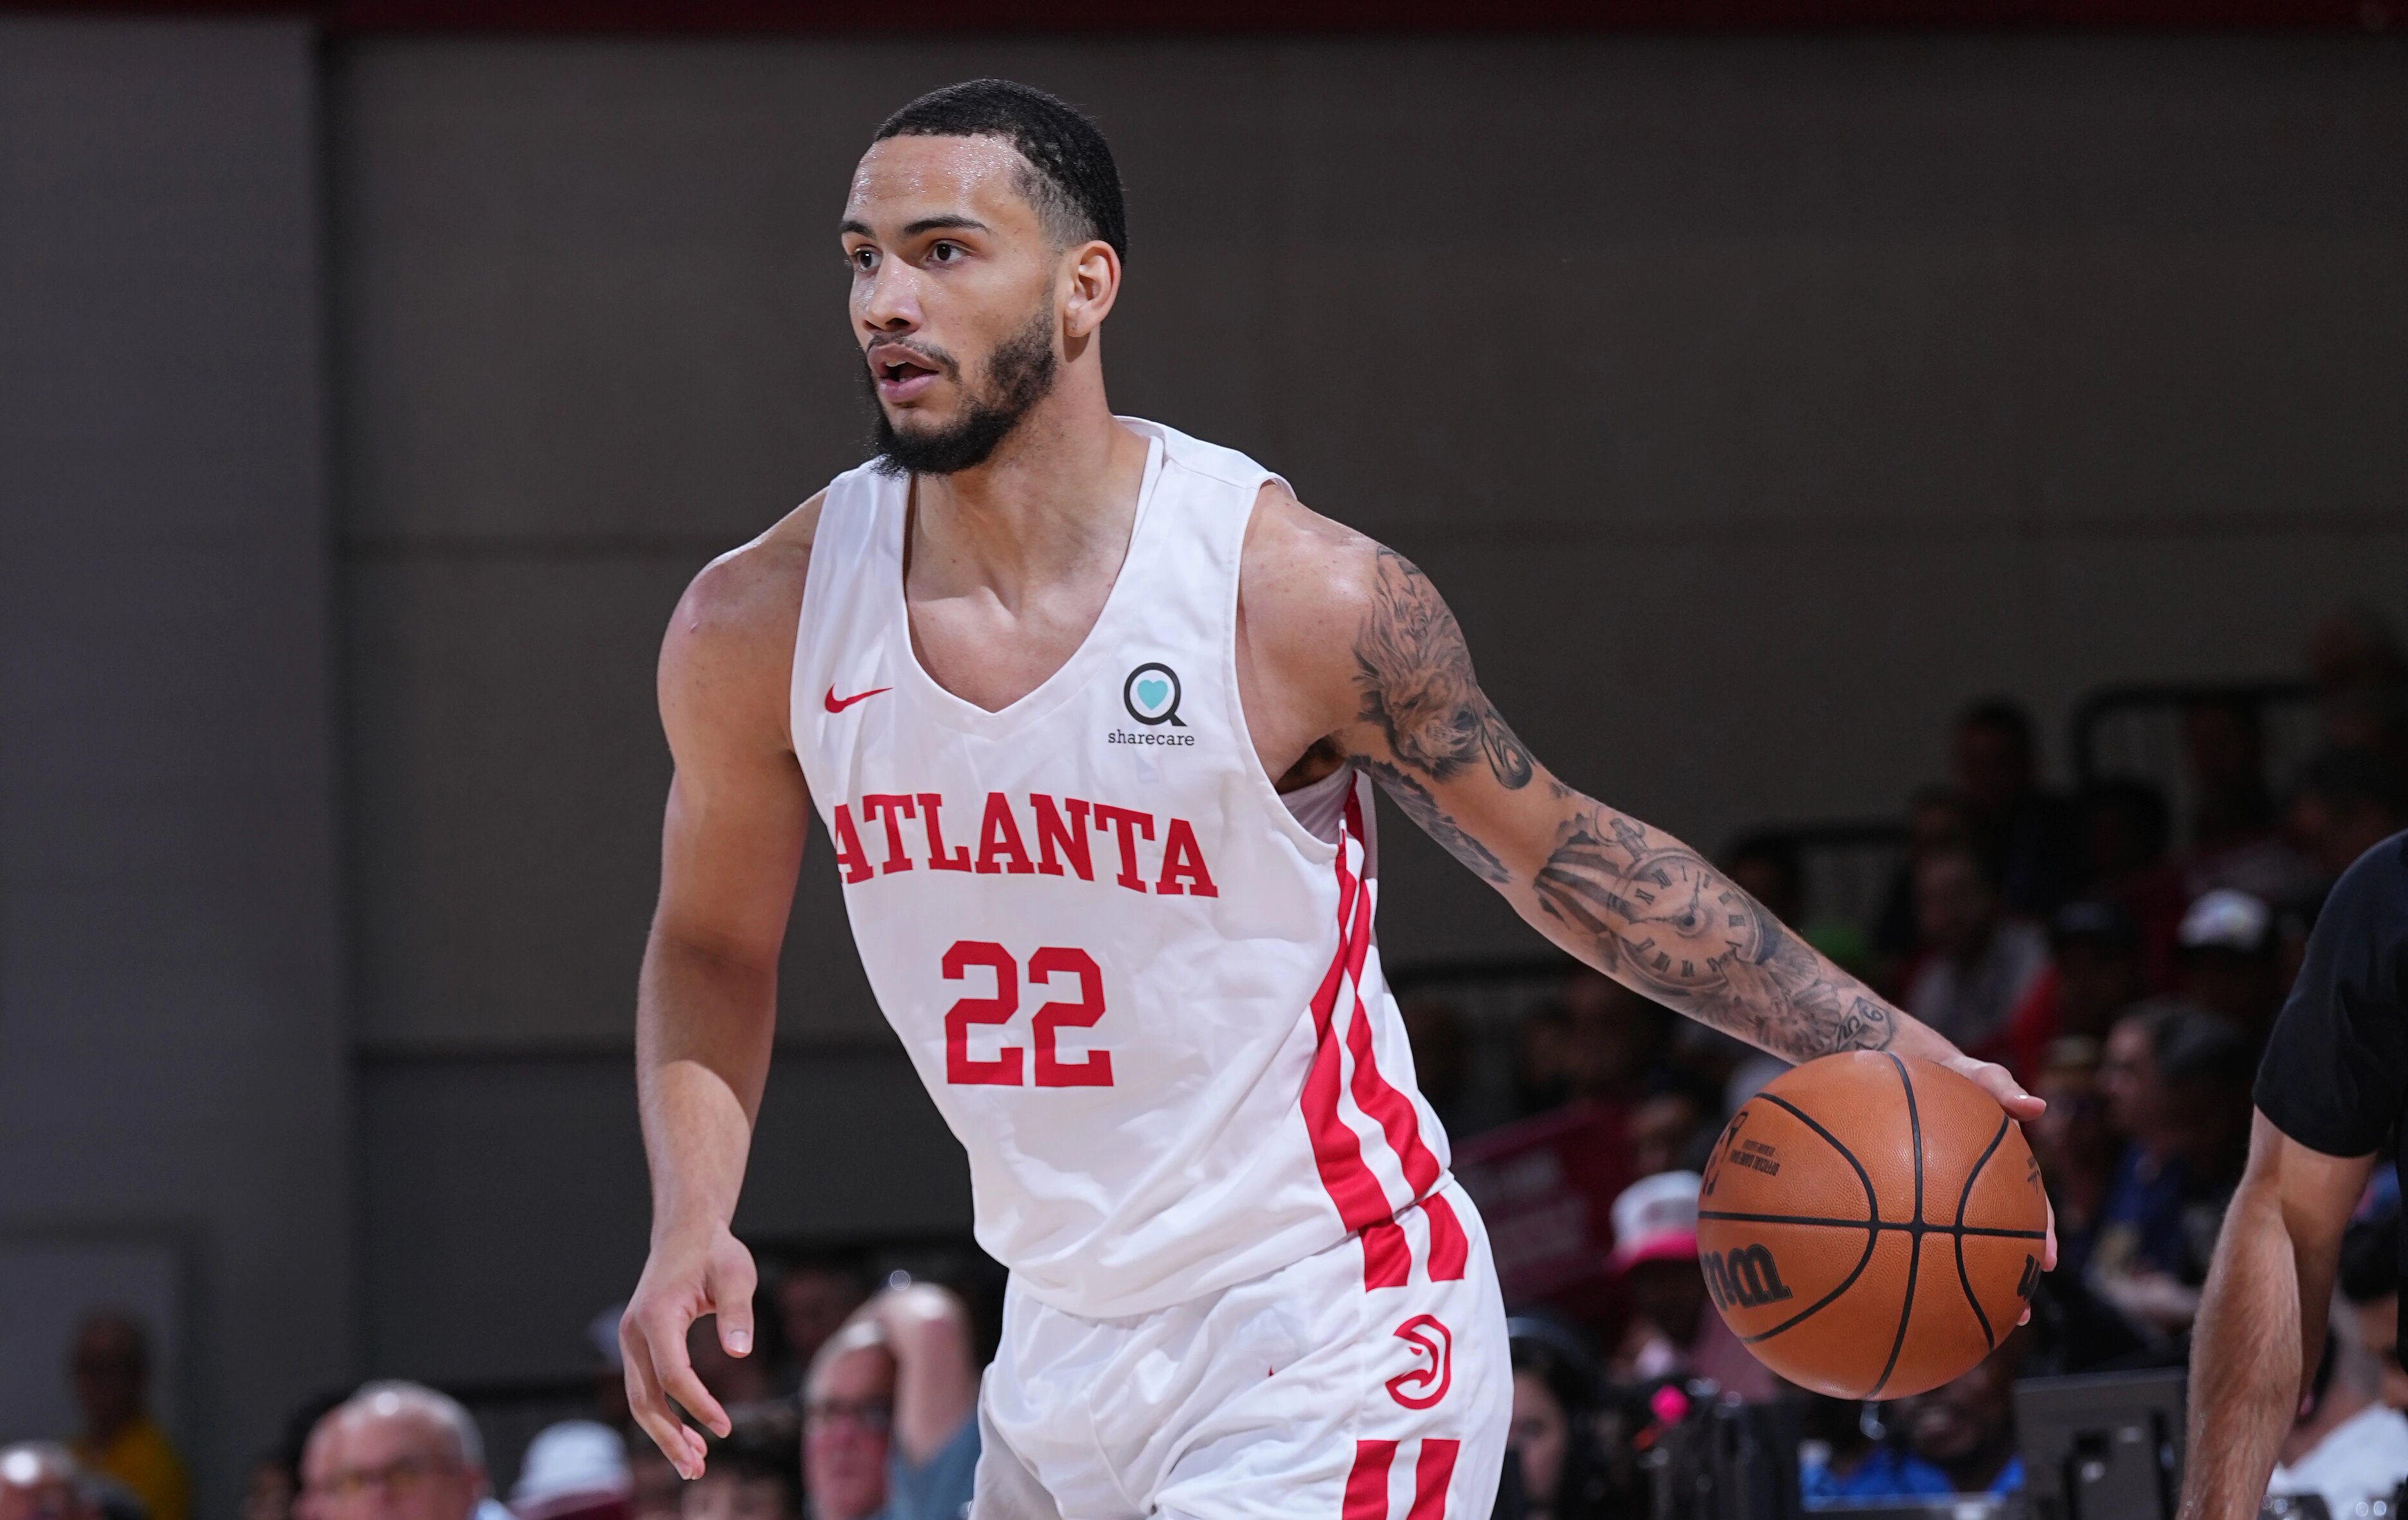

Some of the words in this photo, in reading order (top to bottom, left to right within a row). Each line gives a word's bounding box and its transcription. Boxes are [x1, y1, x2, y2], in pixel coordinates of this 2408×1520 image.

[1108, 728, 1195, 746] sharecare
[834, 792, 1219, 898] ATLANTA
[942, 940, 1114, 1087] 22
